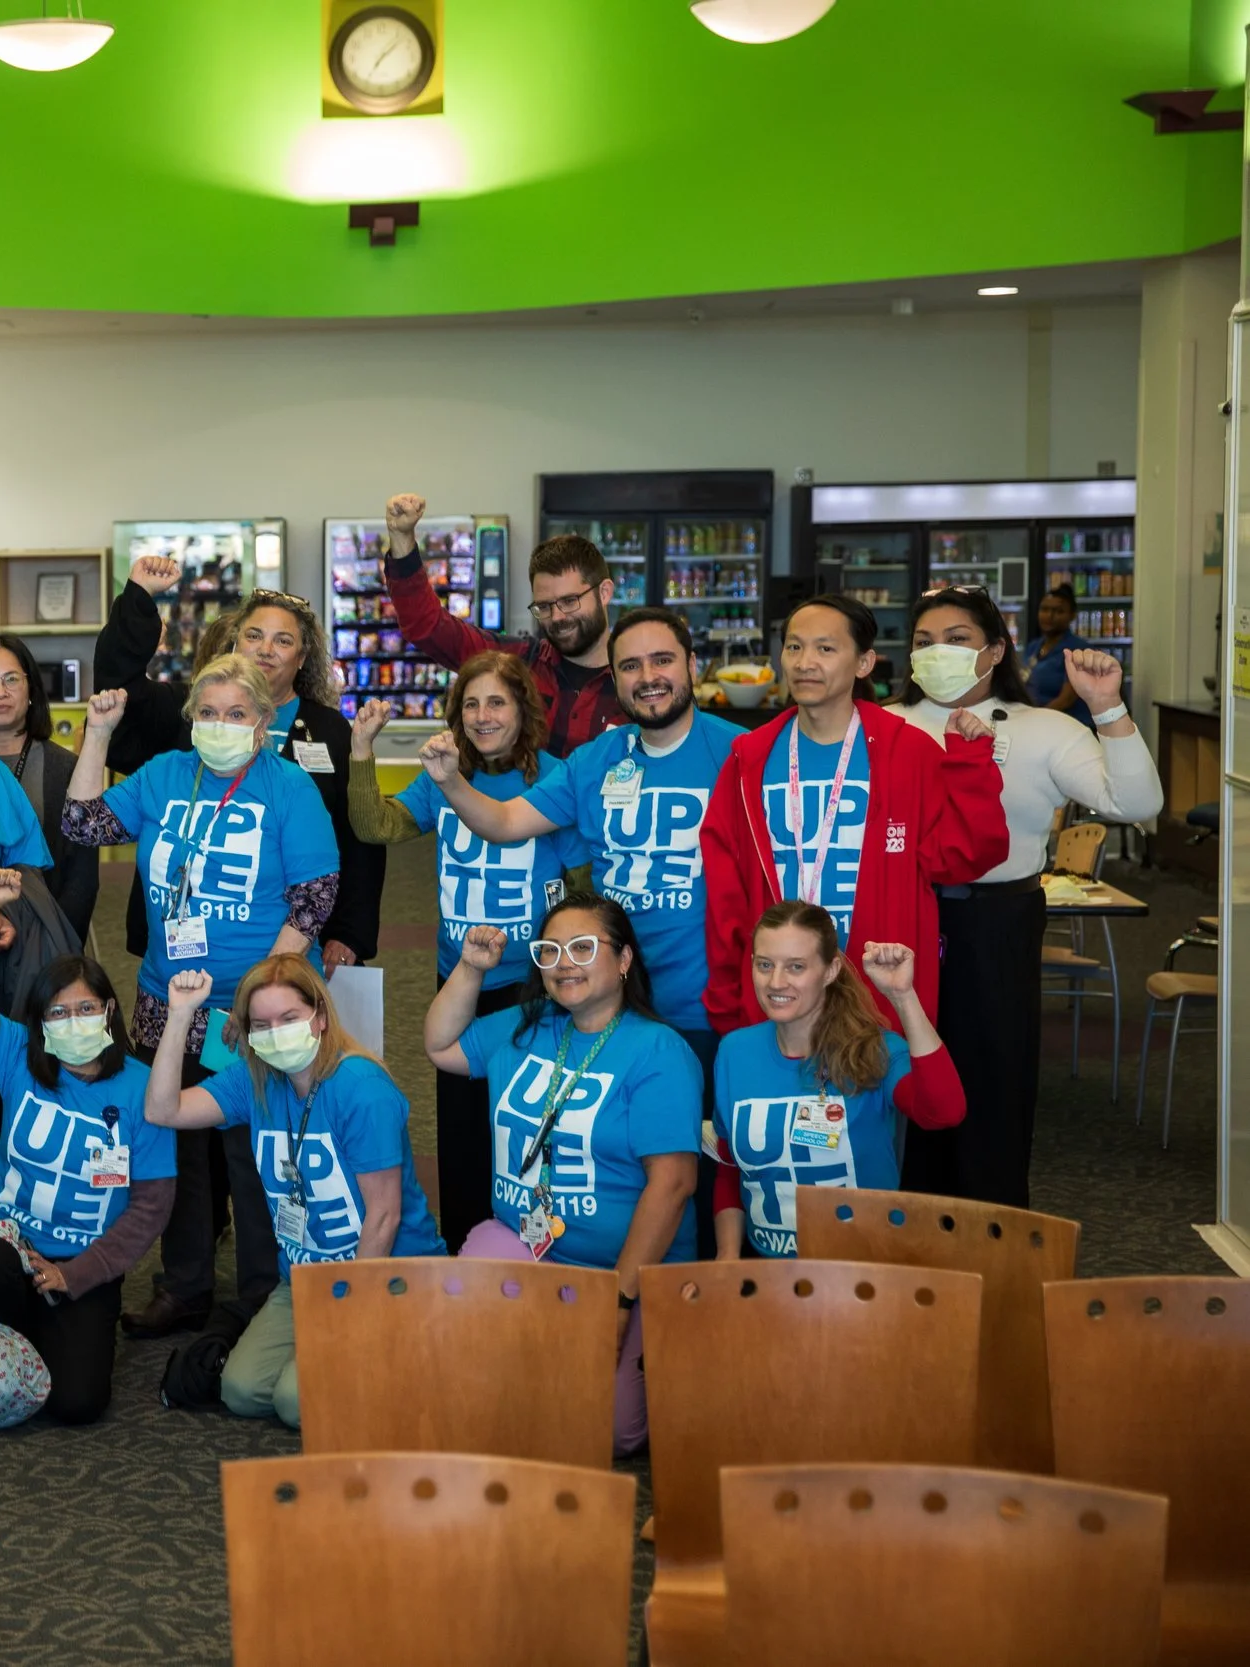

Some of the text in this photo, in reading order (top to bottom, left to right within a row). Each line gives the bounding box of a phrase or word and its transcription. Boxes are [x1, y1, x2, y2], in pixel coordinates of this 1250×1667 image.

[162, 803, 257, 850] UP
[608, 792, 703, 849] UP
[768, 785, 869, 846] UP
[200, 901, 250, 921] 9119
[445, 867, 528, 920] TE
[642, 891, 692, 910] 9119
[508, 1060, 603, 1127] UP
[12, 1097, 109, 1177] UP
[260, 1135, 333, 1198] UP
[497, 1110, 588, 1187] TE
[9, 1156, 112, 1232] TE
[495, 1178, 531, 1211] CWA
